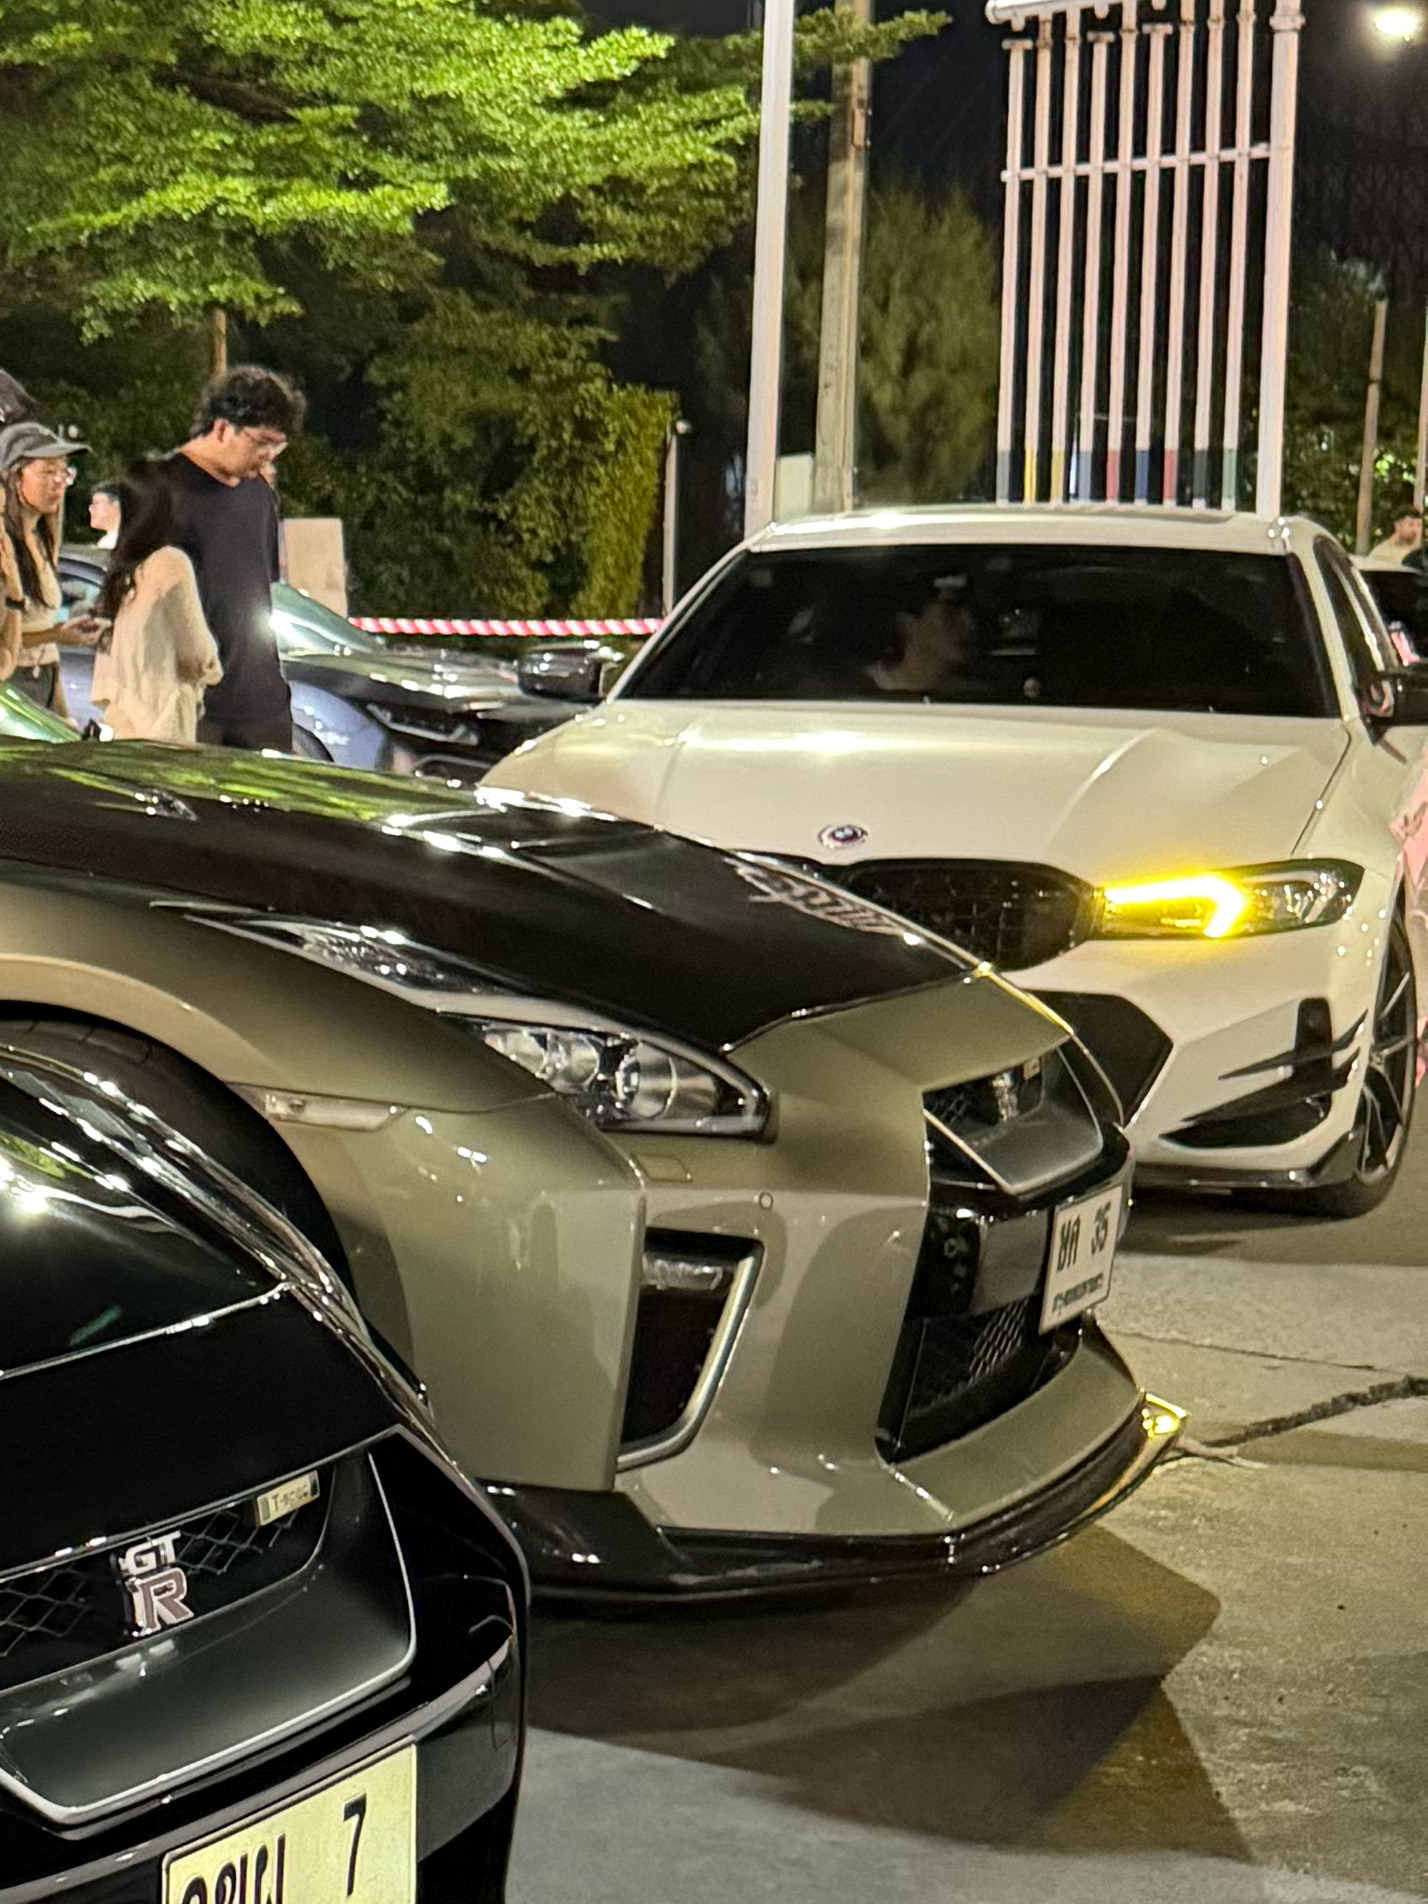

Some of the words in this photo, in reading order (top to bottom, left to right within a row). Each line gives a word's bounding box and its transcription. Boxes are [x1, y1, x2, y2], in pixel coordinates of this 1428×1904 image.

[118, 1530, 182, 1574] GT
[129, 1567, 194, 1638] R
[342, 1791, 368, 1898] 7
